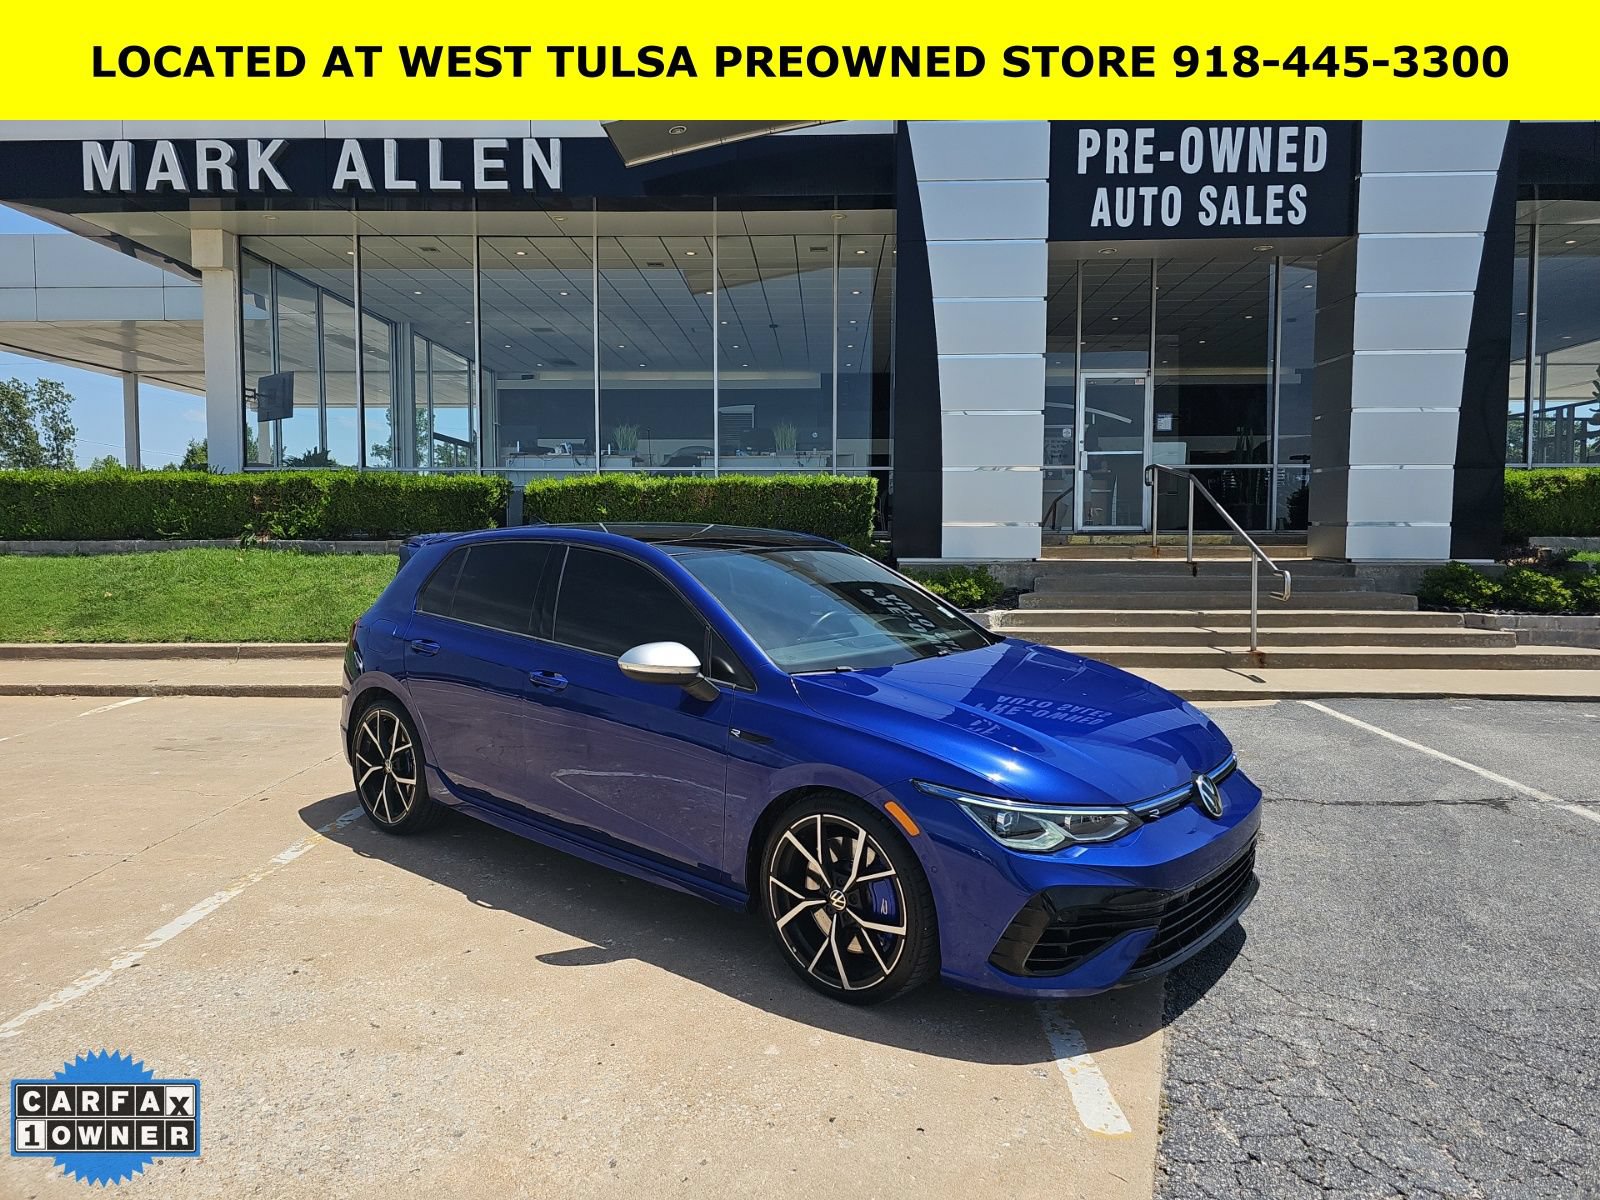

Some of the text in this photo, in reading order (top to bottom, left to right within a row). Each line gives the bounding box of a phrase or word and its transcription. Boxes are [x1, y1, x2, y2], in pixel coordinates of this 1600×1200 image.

[82, 138, 563, 194] MARK ALLEN
[1077, 126, 1328, 174] PRE-OWNED
[1090, 183, 1307, 227] AUTO SALES
